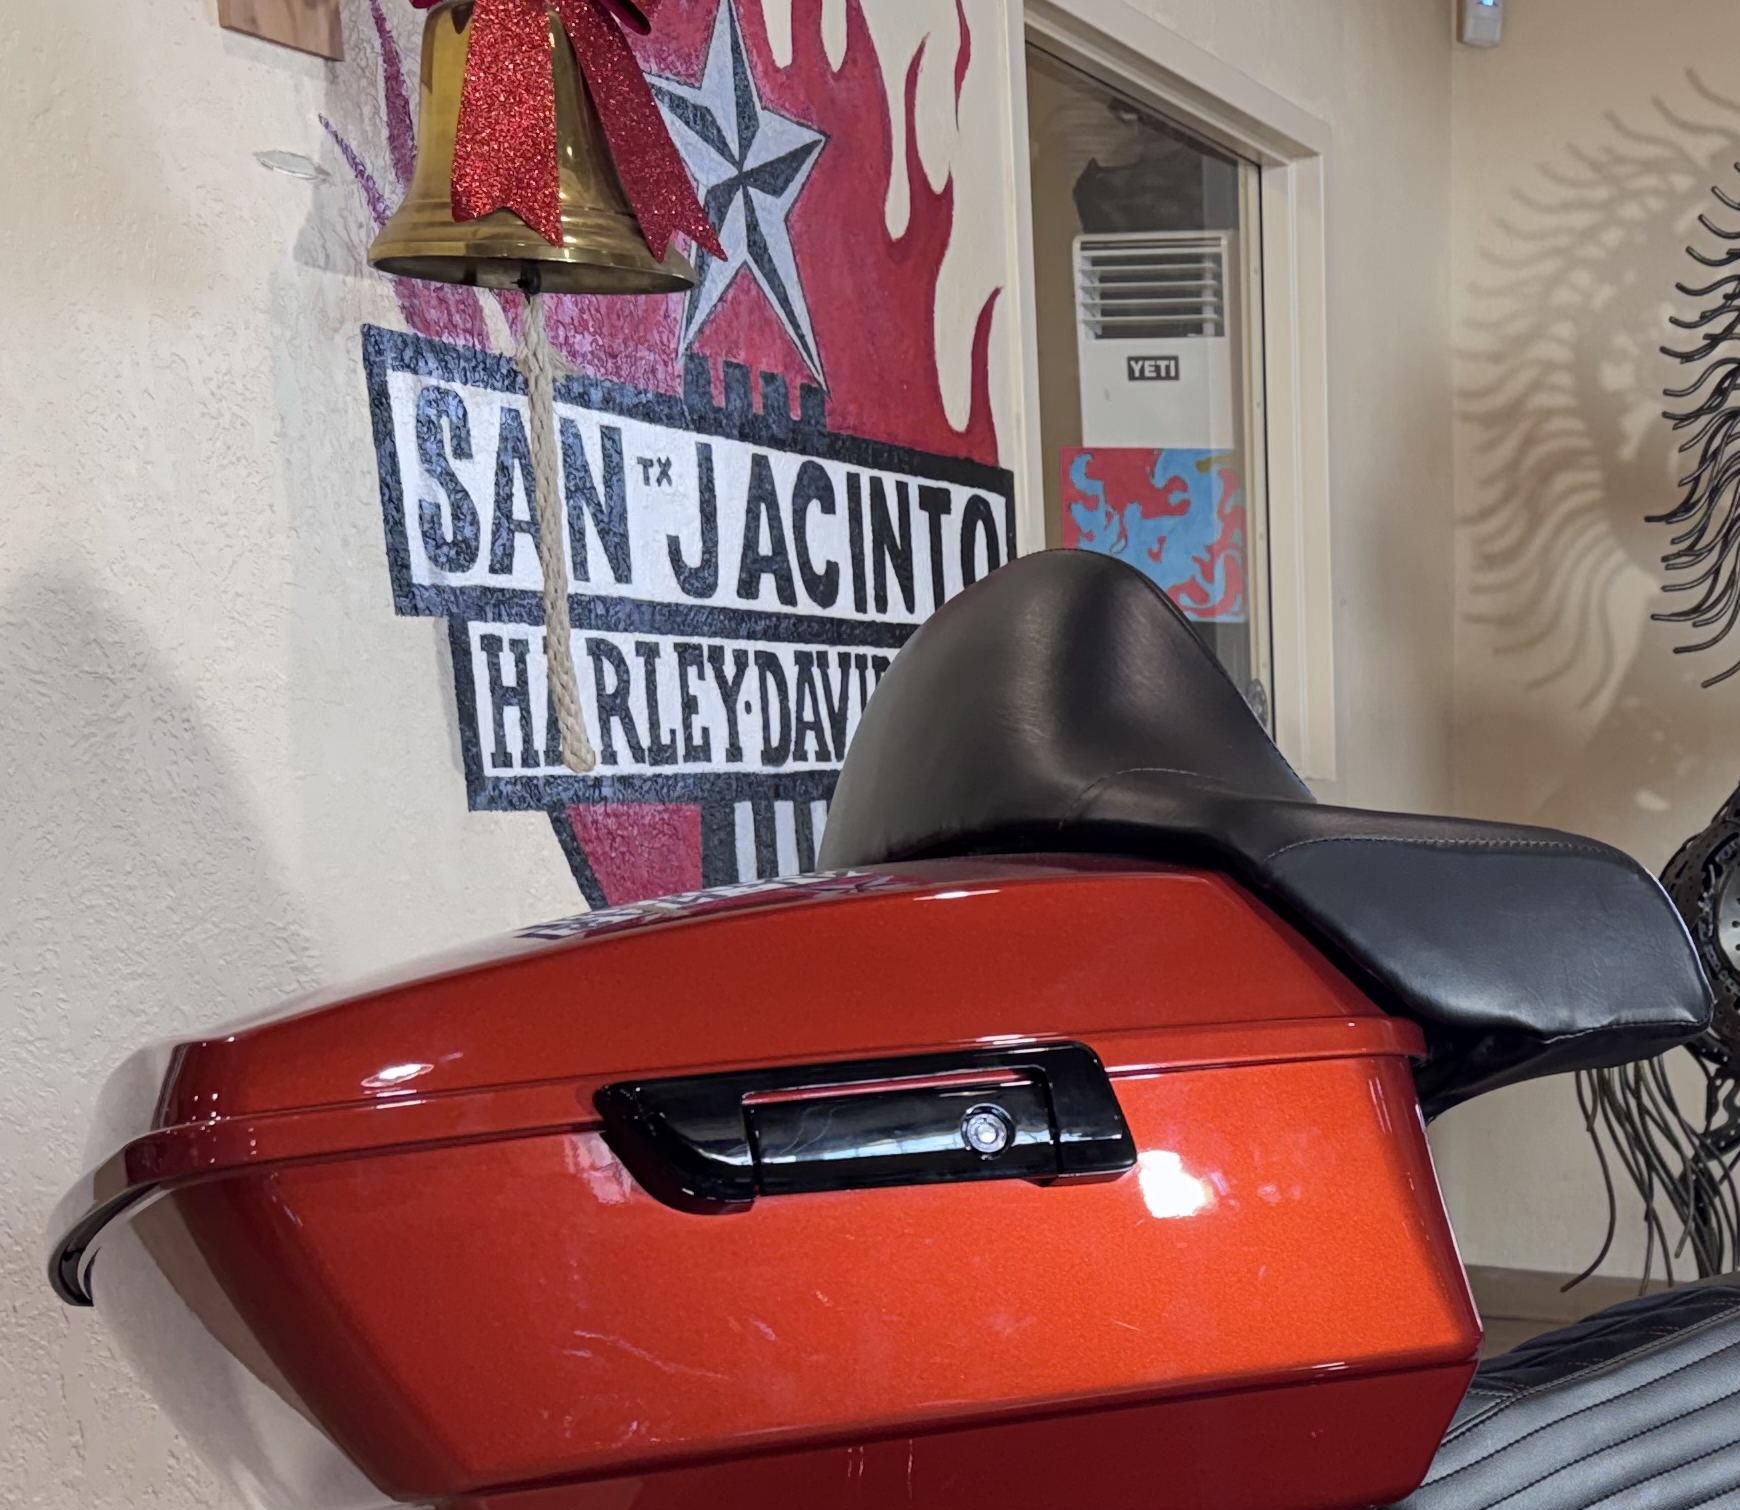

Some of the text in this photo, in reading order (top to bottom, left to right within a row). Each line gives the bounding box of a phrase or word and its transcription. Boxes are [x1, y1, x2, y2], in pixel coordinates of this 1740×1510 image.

[1130, 360, 1176, 378] YETI
[416, 384, 1001, 617] SAN TX JACINTO
